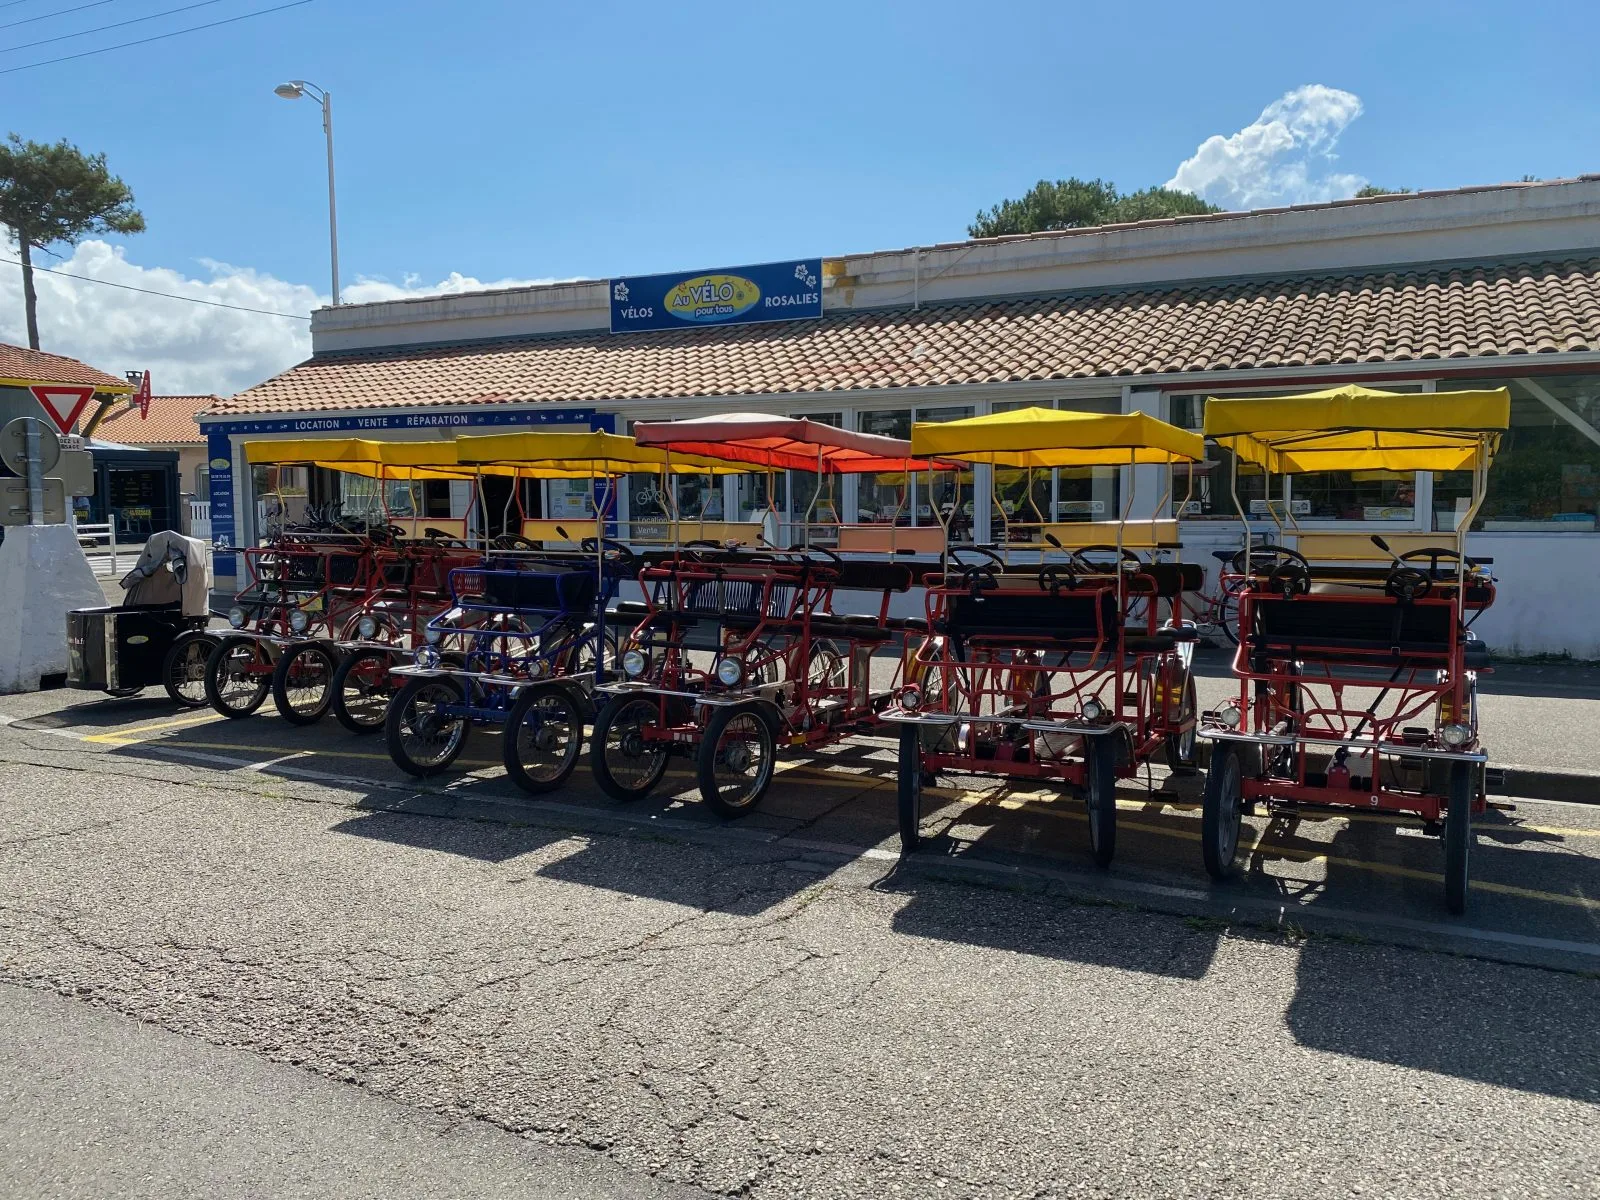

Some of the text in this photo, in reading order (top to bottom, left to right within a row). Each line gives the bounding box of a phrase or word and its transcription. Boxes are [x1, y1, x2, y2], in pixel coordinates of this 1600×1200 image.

[672, 280, 734, 307] Au VÉLO
[765, 292, 819, 308] ROSALIES
[620, 305, 654, 319] VÉLOS
[695, 304, 733, 318] pour tous
[295, 415, 468, 430] LOCATION VENTE RÉPARATION
[637, 526, 658, 534] Vente
[1370, 795, 1379, 806] 9
